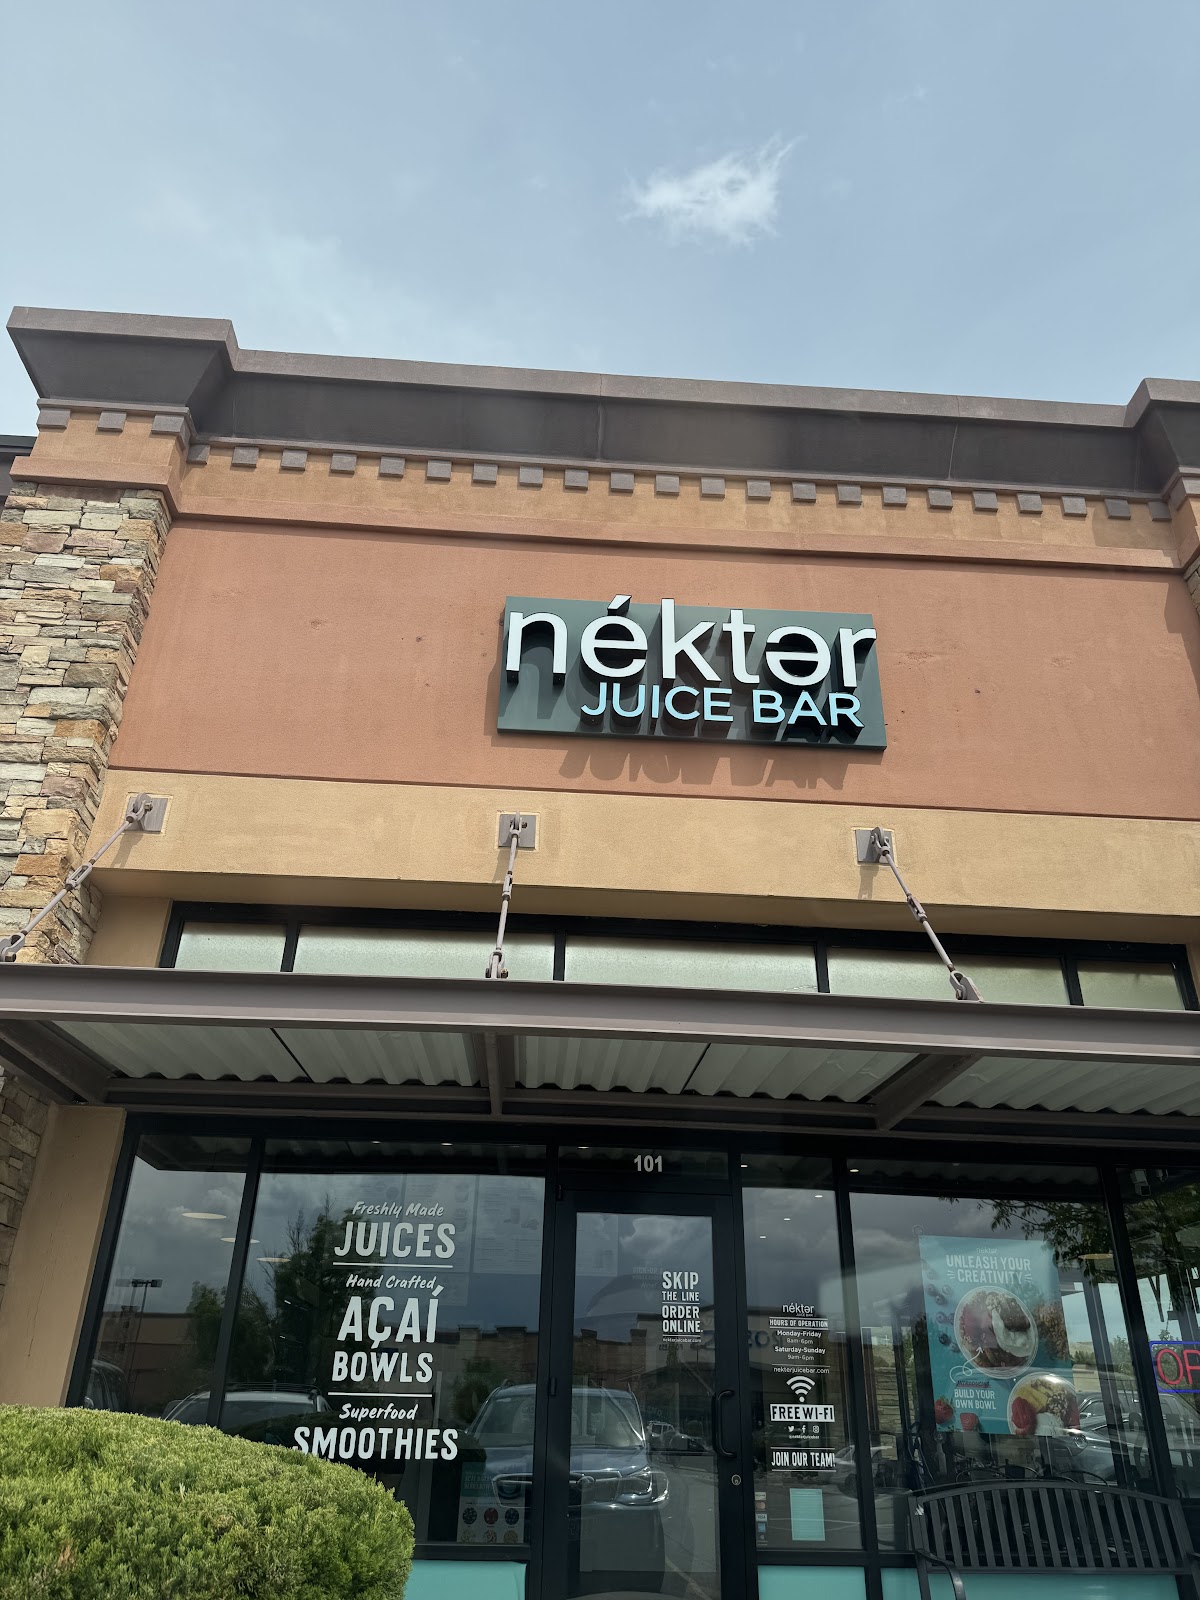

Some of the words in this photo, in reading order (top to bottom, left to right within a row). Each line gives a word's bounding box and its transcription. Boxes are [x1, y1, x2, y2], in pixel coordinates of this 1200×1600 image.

[581, 682, 733, 722] JUICE
[753, 689, 864, 728] BAR
[634, 1154, 663, 1172] 101
[352, 1201, 403, 1220] Freshly
[406, 1202, 444, 1217] Made
[334, 1221, 456, 1259] JUICES
[946, 1254, 998, 1270] UNLEASH
[1000, 1257, 1031, 1271] YOUR
[346, 1273, 383, 1288] Hand
[386, 1274, 436, 1289] Crafted
[662, 1271, 699, 1289] SKIP
[957, 1269, 1022, 1284] CREATIVITY
[661, 1291, 677, 1301] THE
[681, 1291, 700, 1301] LINE
[337, 1284, 444, 1349] AÇAÍ
[661, 1305, 700, 1318] ORDER
[662, 1319, 703, 1333] ONLINE.
[798, 1320, 828, 1328] OPERATION
[331, 1351, 433, 1383] BOWLS
[954, 1388, 974, 1399] BUILD
[975, 1389, 995, 1400] YOUR
[339, 1403, 418, 1422] Superfood
[772, 1406, 800, 1420] FREE
[802, 1407, 833, 1420] WI-FI
[955, 1399, 974, 1409] OWN
[974, 1400, 996, 1410] BOWL
[293, 1426, 458, 1460] SMOOTHIES
[771, 1451, 790, 1466] JOIN
[791, 1451, 808, 1467] OUR
[810, 1452, 836, 1468] TEAM!
